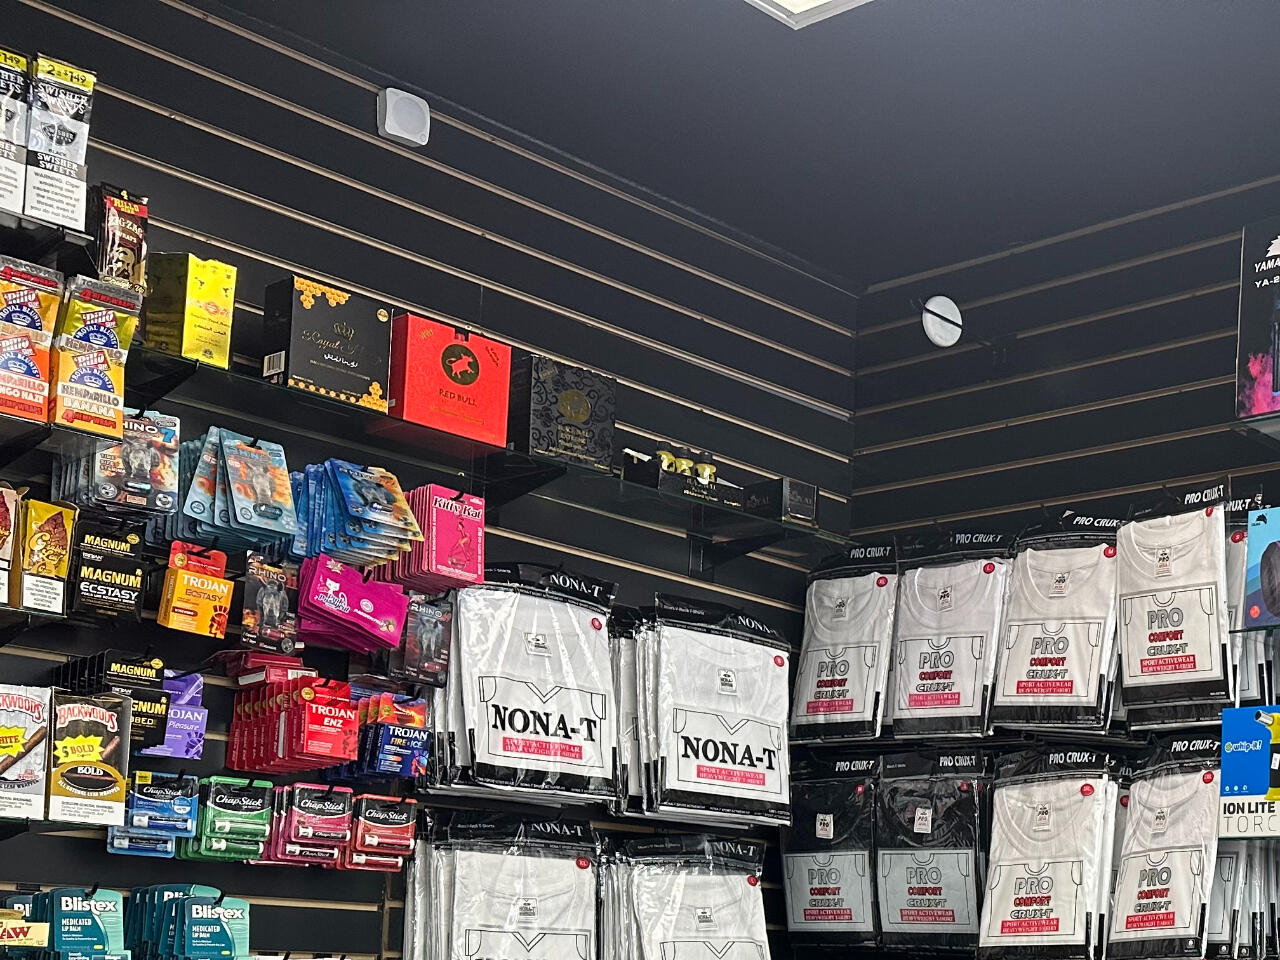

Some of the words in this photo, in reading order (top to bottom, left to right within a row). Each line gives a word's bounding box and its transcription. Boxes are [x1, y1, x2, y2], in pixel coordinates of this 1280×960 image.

[37, 153, 78, 171] SWISHER
[39, 161, 77, 178] SWEETS
[1255, 258, 1280, 272] YAMA
[22, 390, 44, 404] HAZE
[63, 399, 116, 418] BANANA
[160, 429, 176, 443] 7
[1185, 491, 1202, 504] PRO
[1202, 485, 1224, 501] CRUX-T
[432, 496, 461, 513] Kitty
[462, 503, 482, 519] Kat
[84, 535, 130, 552] MAGNUM
[955, 533, 971, 544] PRO
[972, 533, 1002, 543] CRUX-T
[850, 548, 864, 559] PRO
[867, 547, 891, 557] CRUX-T
[80, 566, 141, 588] MAGNUM
[248, 566, 287, 582] RHINO
[80, 582, 139, 600] ECSTASY
[182, 574, 229, 594] TROJAN
[550, 573, 603, 598] NONA-T
[185, 588, 224, 603] ECSTASY
[410, 602, 443, 619] RHINO
[1147, 608, 1183, 629] PRO
[1148, 630, 1184, 643] COMFORT
[1147, 643, 1188, 656] CRUX-T
[919, 651, 954, 669] PRO
[111, 662, 156, 678] MAGNUM
[817, 660, 849, 677] PRO
[916, 682, 954, 692] CRUX-T
[57, 704, 118, 732] BACKWOODS
[311, 703, 355, 720] TROJAN
[323, 718, 343, 727] ENZ
[491, 703, 597, 743] NONA-T
[389, 726, 428, 741] TROJAN
[70, 745, 94, 754] BOLD
[390, 738, 407, 746] FIRE
[680, 735, 777, 771] NONA-T
[1049, 753, 1065, 764] PRO
[1066, 752, 1096, 763] CRUX-T
[940, 756, 953, 767] PRO
[954, 755, 976, 767] CRUX-T
[77, 766, 104, 776] BOLD
[143, 786, 182, 796] ChapStick
[215, 795, 263, 807] ChapStick
[300, 799, 344, 811] ChapStick
[1223, 802, 1247, 815] ION
[1249, 802, 1275, 814] LITE
[366, 809, 408, 820] ChapStick
[529, 822, 584, 837] NONA-T
[712, 841, 757, 856] NONA-T
[906, 867, 942, 884] PRO
[908, 887, 942, 896] COMFORT
[1014, 876, 1053, 895] PRO
[61, 896, 118, 914] Blistex
[907, 899, 946, 907] CRUX-T
[1013, 896, 1051, 907] COMFORT
[191, 904, 244, 922] Blistex
[1010, 909, 1053, 919] CRUX-T
[61, 918, 92, 926] MEDICATED
[192, 925, 221, 933] MEDICATED
